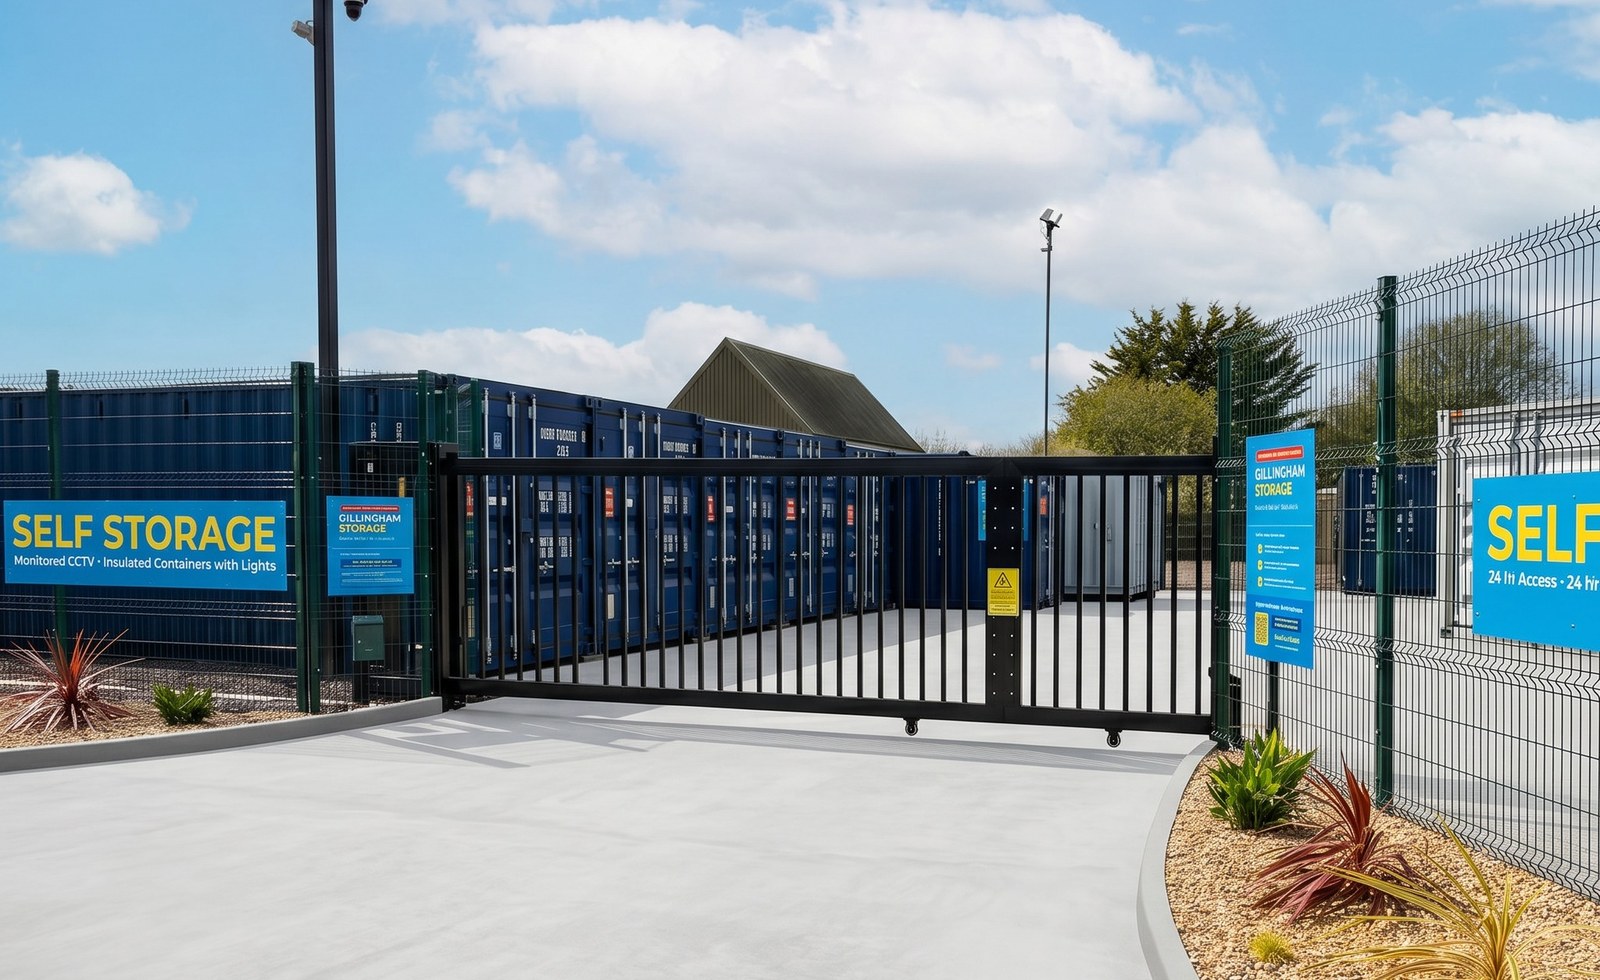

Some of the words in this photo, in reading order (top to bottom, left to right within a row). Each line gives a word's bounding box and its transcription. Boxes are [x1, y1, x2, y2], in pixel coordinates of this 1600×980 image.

[1255, 464, 1306, 481] GILLINGHAM
[1255, 481, 1293, 497] STORAGE
[338, 513, 401, 523] GILLINGHAM
[12, 513, 93, 549] SELF
[103, 514, 277, 553] STORAGE
[338, 523, 387, 533] STORAGE
[1487, 503, 1600, 564] SELF
[14, 554, 66, 567] Monitored
[67, 556, 95, 568] CCTV
[103, 556, 152, 569] Insulated
[154, 557, 212, 571] Containers
[214, 558, 239, 571] with
[241, 559, 277, 575] Lights
[1488, 570, 1502, 584] 24
[1517, 572, 1558, 589] Access
[1566, 575, 1583, 591] 24
